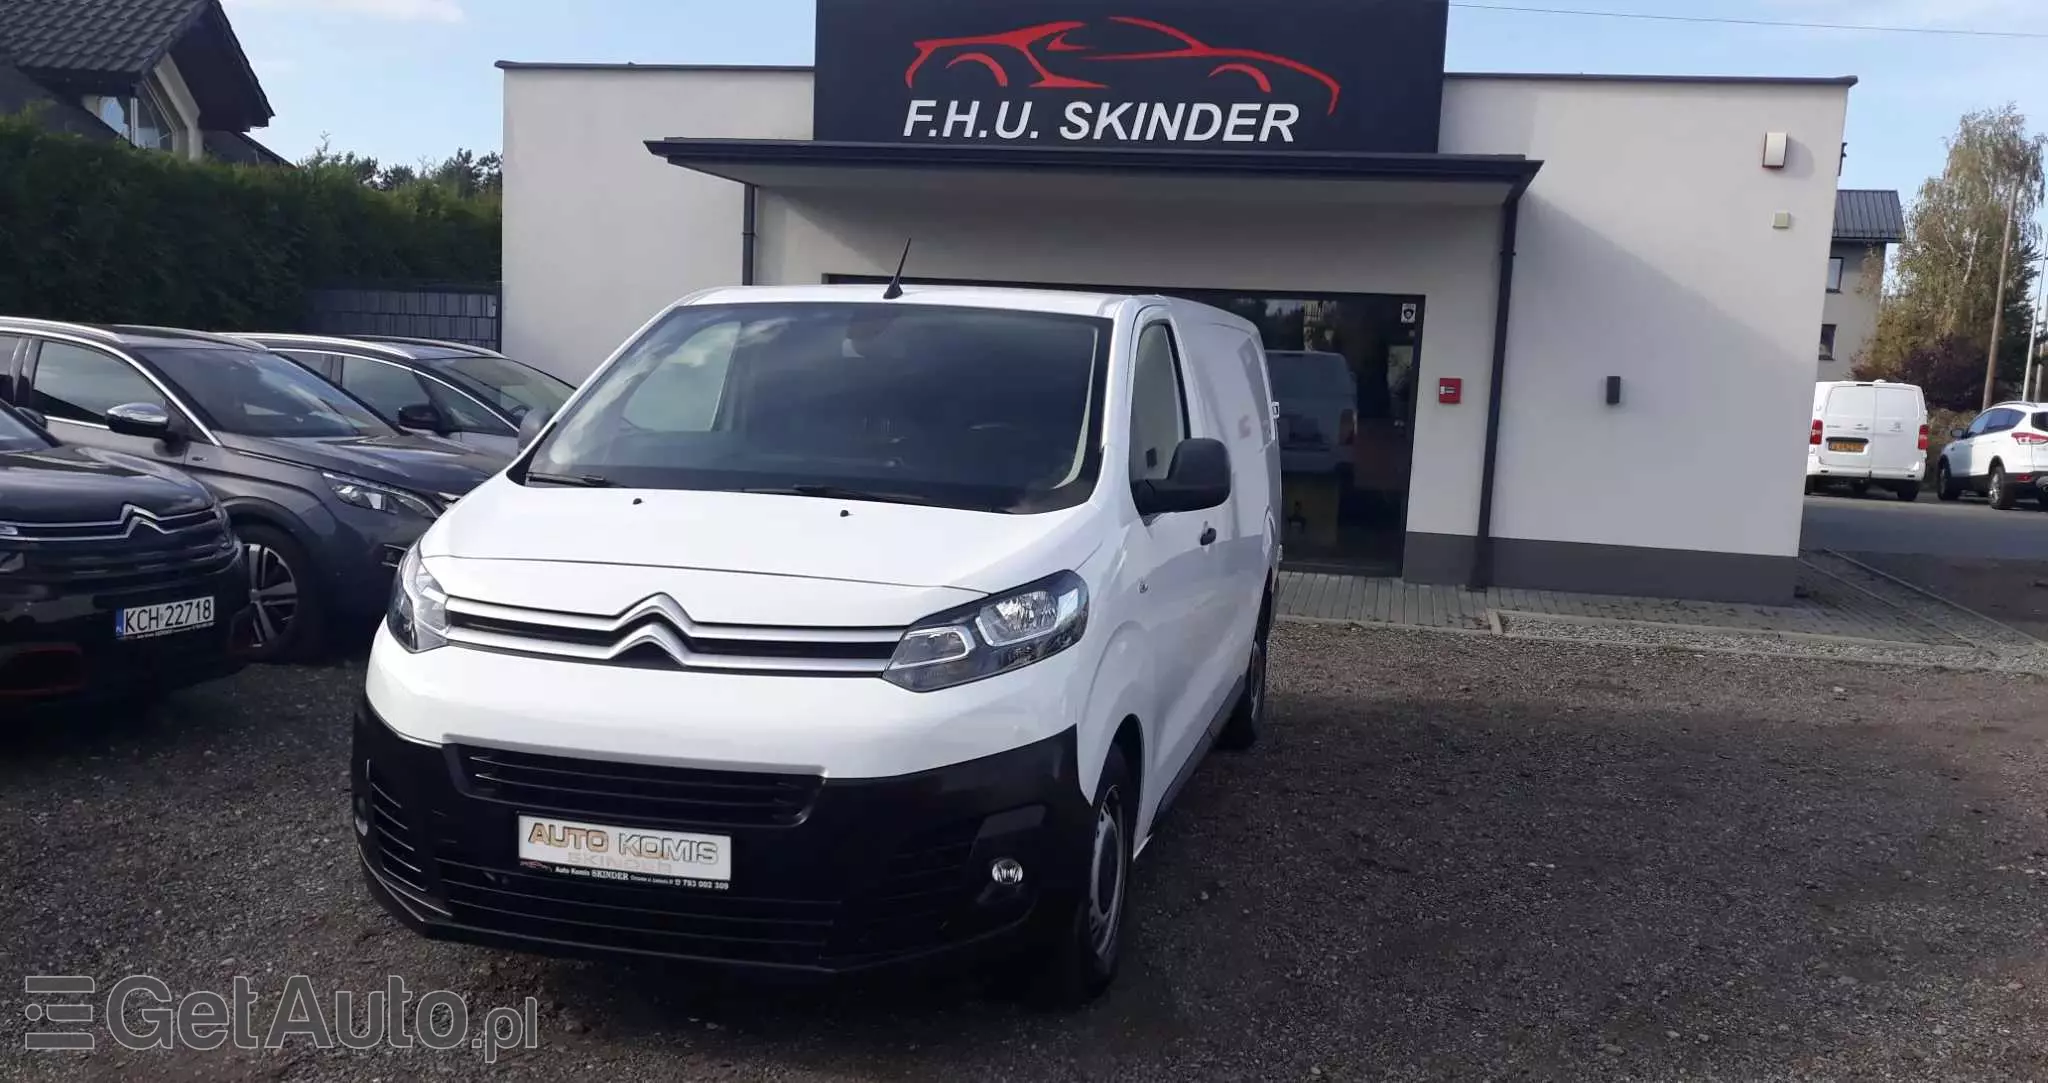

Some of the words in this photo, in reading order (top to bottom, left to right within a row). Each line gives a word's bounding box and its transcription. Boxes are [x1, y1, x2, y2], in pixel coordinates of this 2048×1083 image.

[902, 99, 1039, 140] F.H.U.
[1059, 100, 1300, 143] SKINDER
[125, 607, 160, 634] KCH
[164, 599, 212, 628] 22718
[528, 822, 609, 853] AUTO
[618, 832, 719, 866] KOMIS
[591, 869, 629, 881] SKINDER
